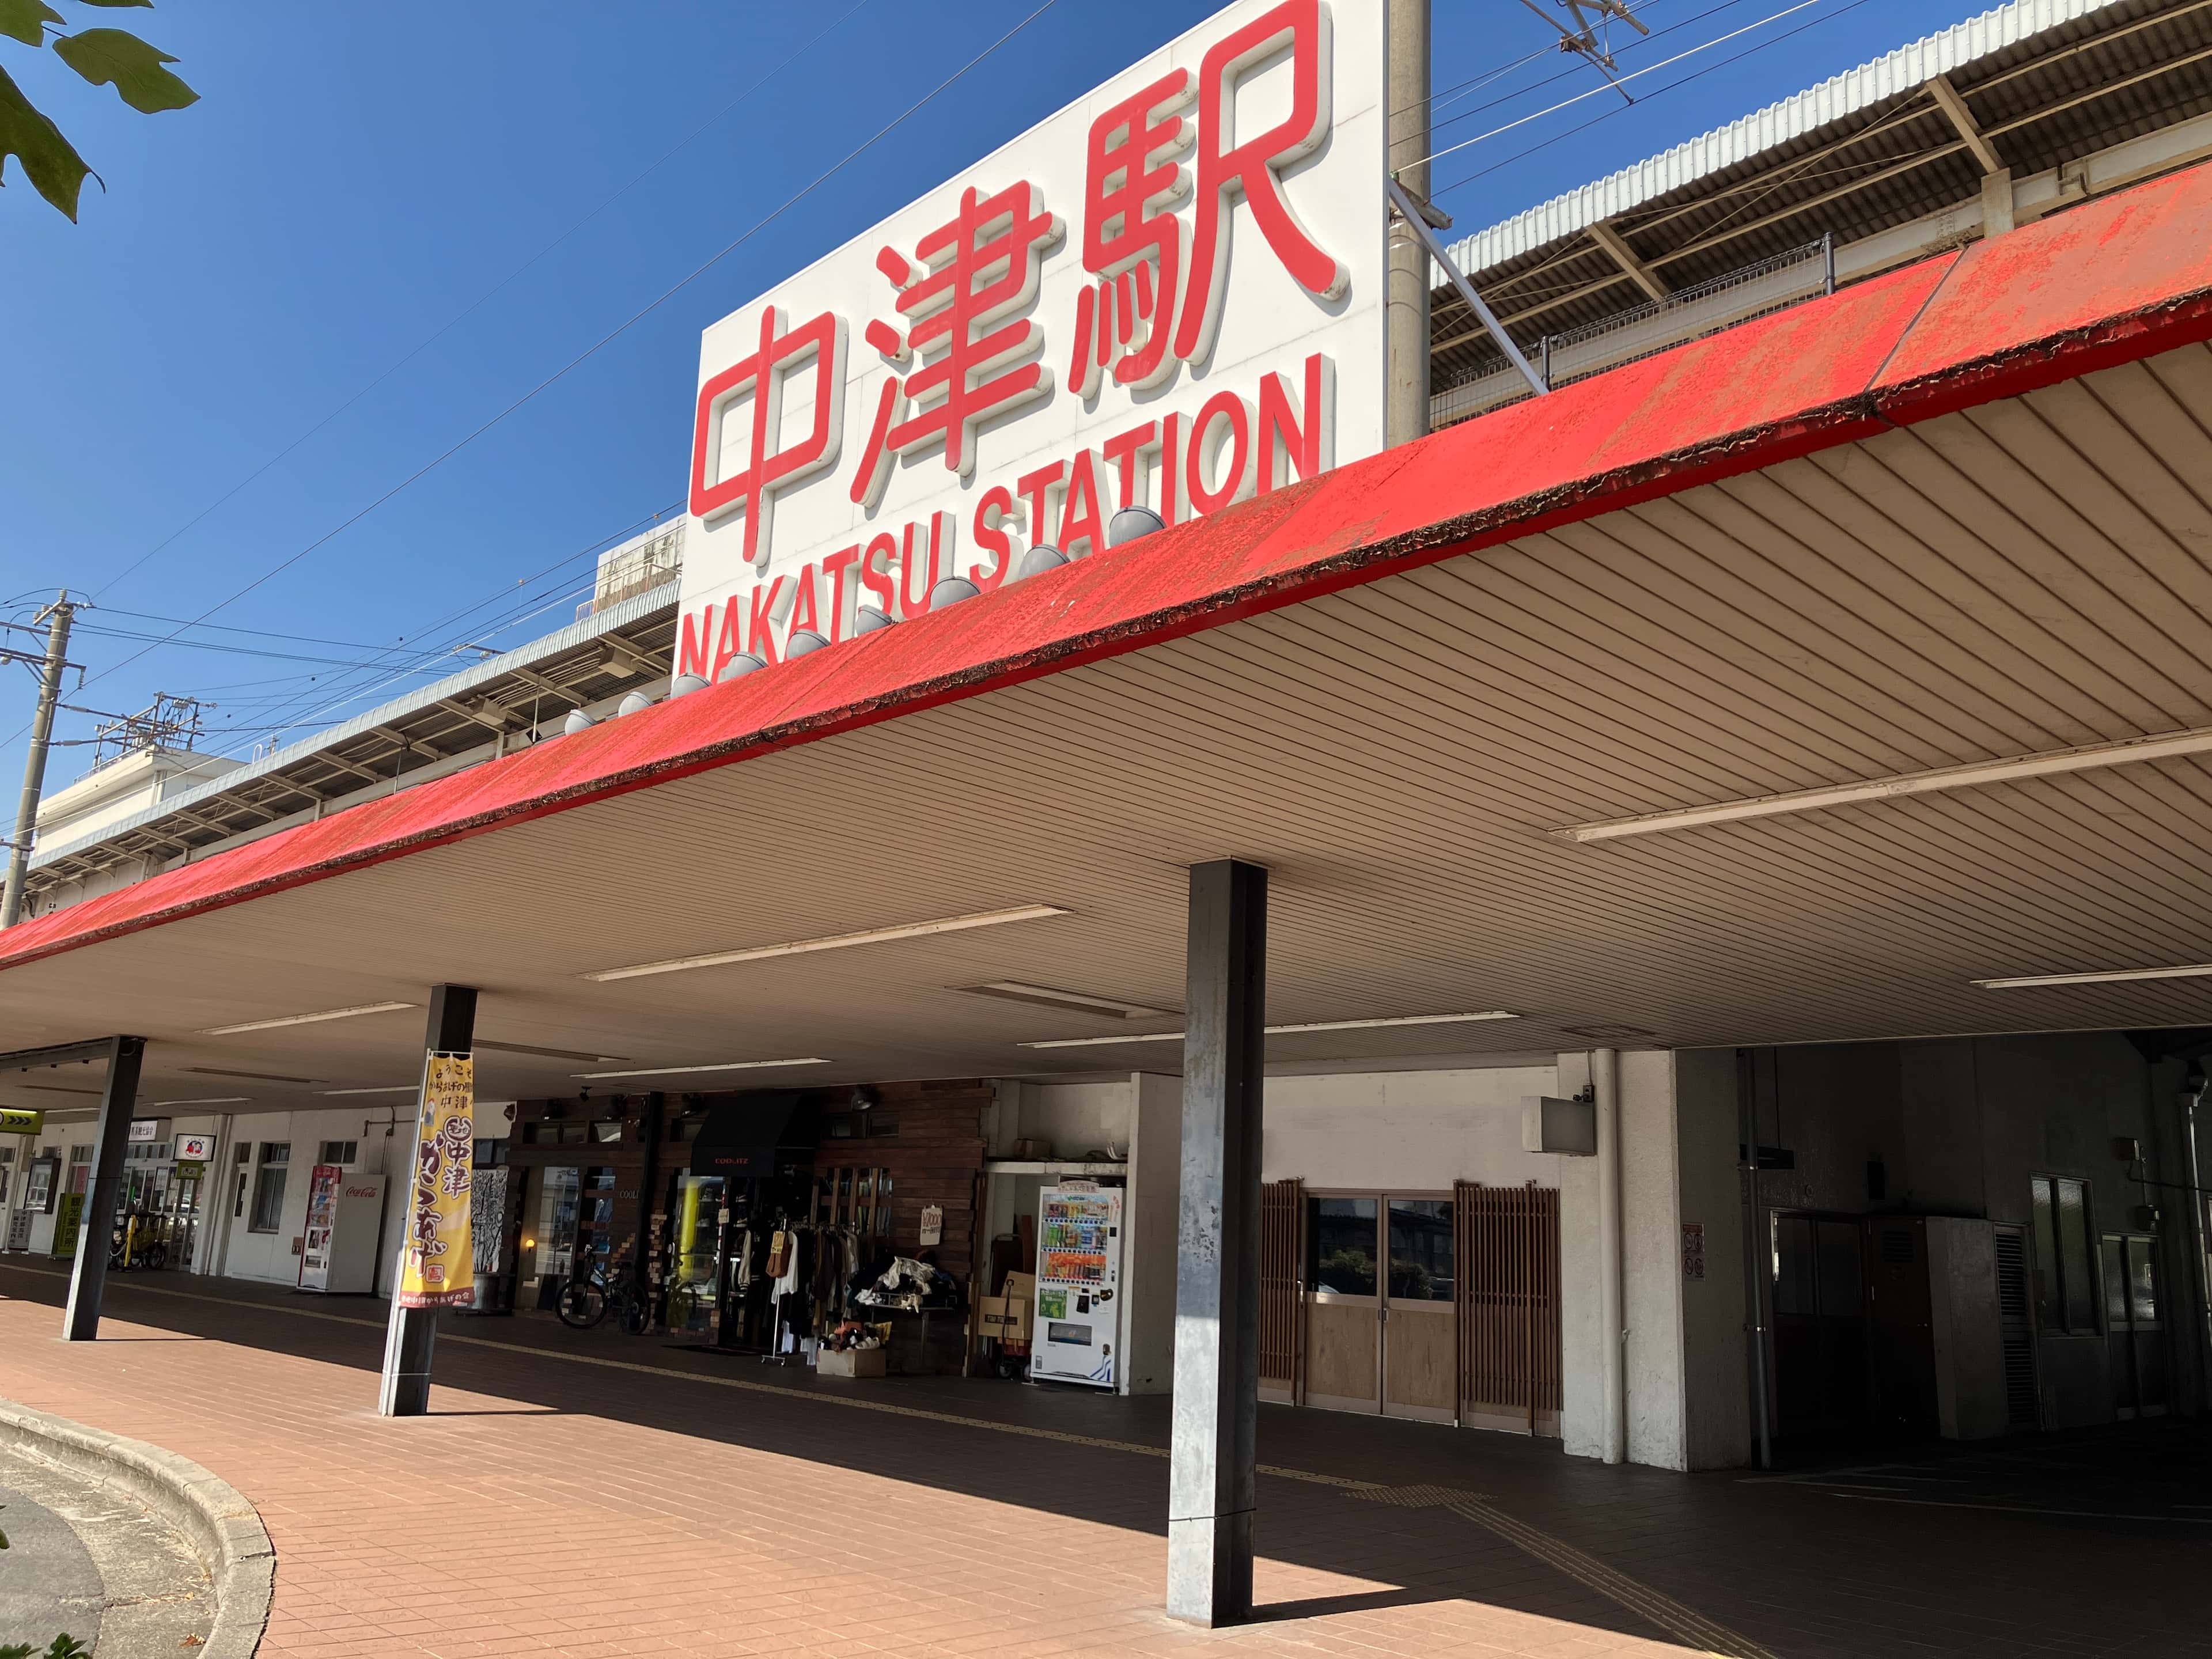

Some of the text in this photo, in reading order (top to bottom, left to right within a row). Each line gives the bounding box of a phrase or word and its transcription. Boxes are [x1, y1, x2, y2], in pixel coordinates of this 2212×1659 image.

[690, 0, 1341, 563] 中津駅
[680, 352, 1324, 683] NAKATSU STATION
[429, 1082, 472, 1093] からあげの聖
[436, 1064, 472, 1079] ようこそ
[442, 1142, 471, 1199] 中津
[65, 1197, 81, 1247] 観光案内所
